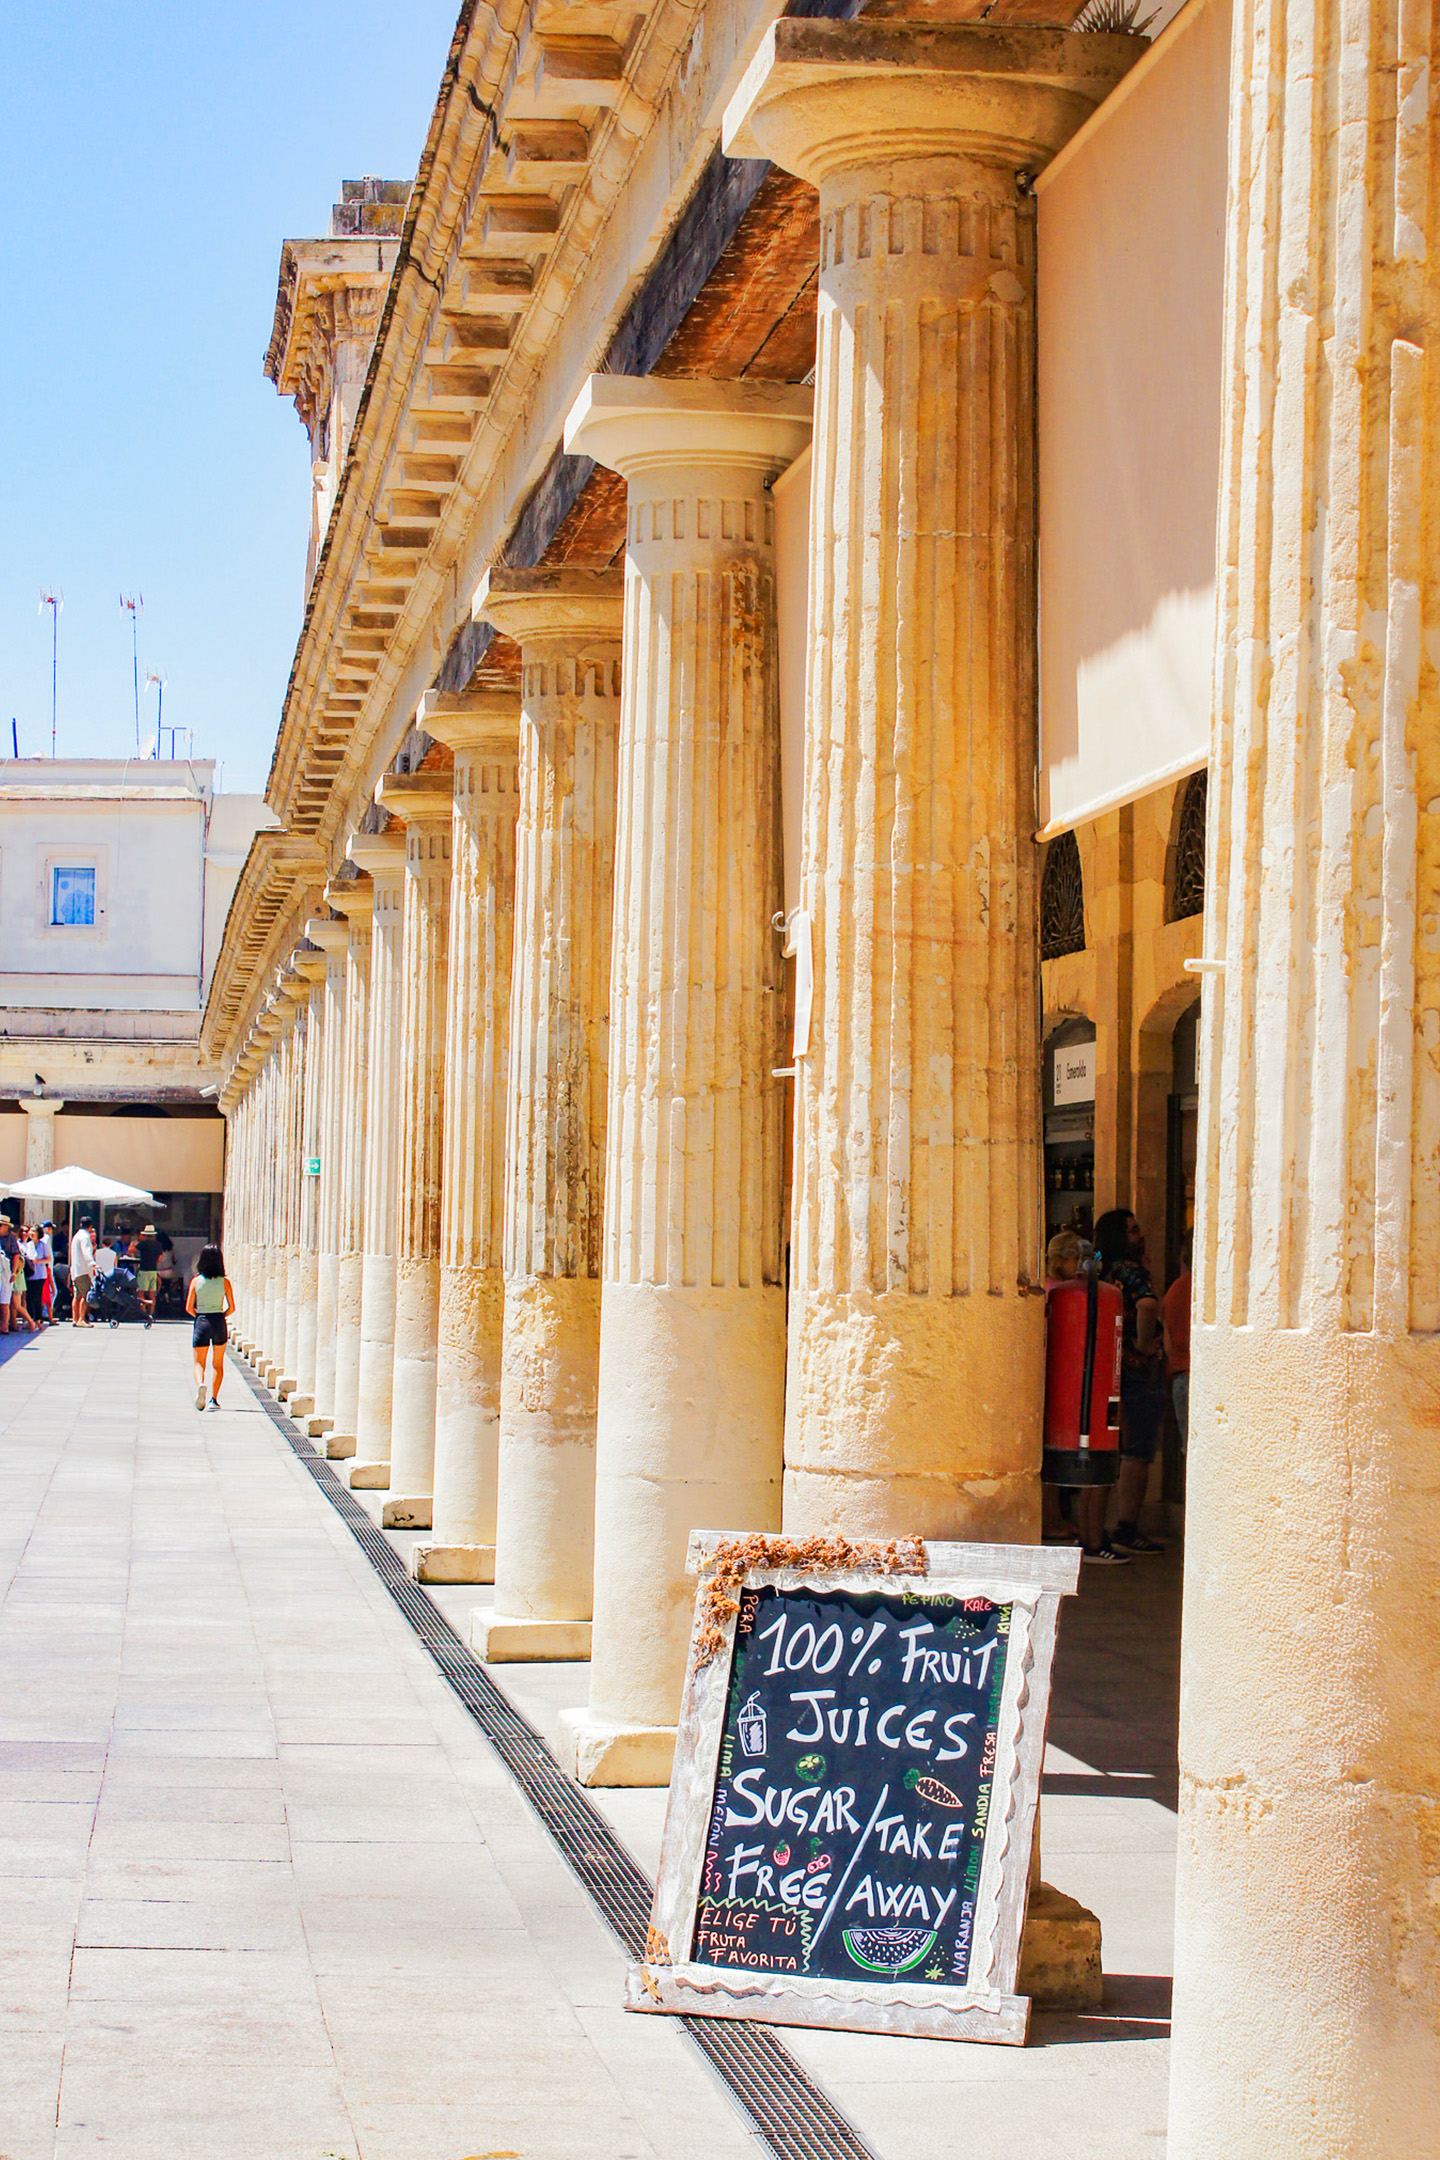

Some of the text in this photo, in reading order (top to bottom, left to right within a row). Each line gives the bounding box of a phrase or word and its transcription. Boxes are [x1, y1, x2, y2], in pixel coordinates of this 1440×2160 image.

[739, 1594, 760, 1634] PERA
[902, 1594, 992, 1612] PEPINO KALE
[759, 1612, 887, 1677] 100%
[979, 1731, 997, 1778] FRESA
[724, 1767, 965, 1861] SUGAR TAKE
[971, 1783, 991, 1839] SANDIA
[725, 1843, 957, 1930] FREE AWAY
[698, 1930, 746, 1948] FRUTA
[700, 1907, 797, 1936] ELIGE TÚ
[951, 1900, 974, 1976] NARANJA
[708, 1947, 797, 1970] FAVORITA
